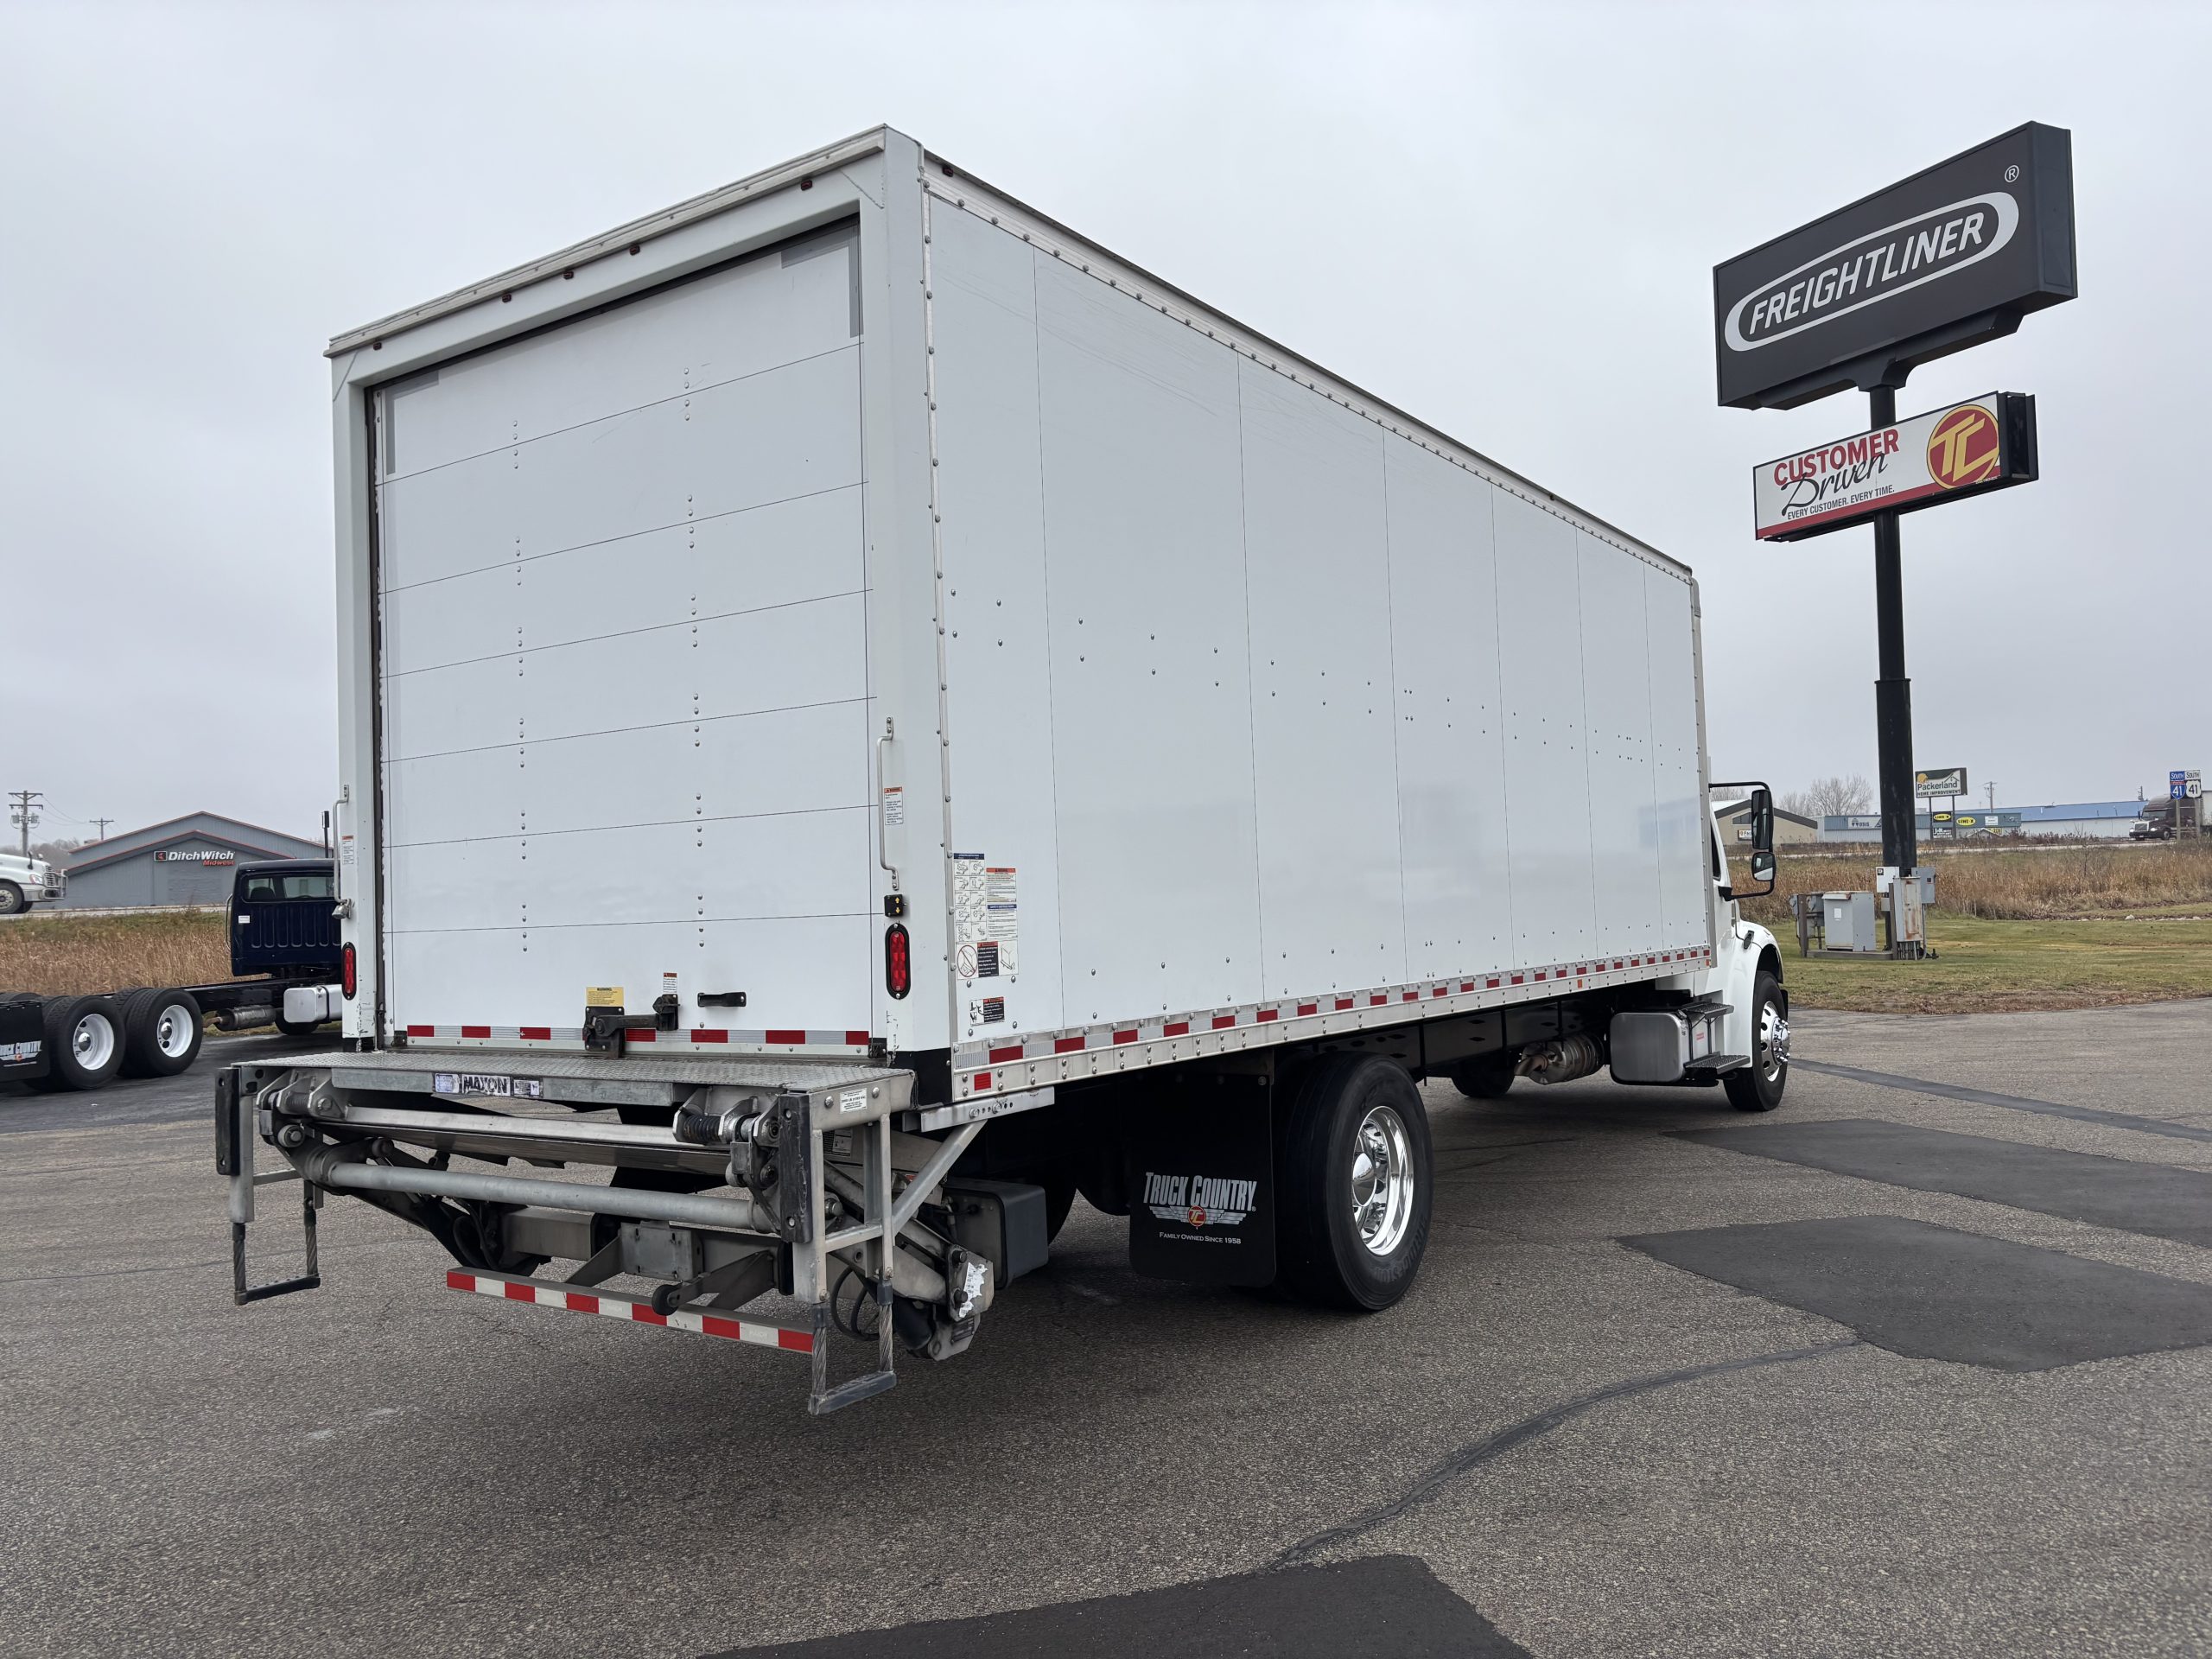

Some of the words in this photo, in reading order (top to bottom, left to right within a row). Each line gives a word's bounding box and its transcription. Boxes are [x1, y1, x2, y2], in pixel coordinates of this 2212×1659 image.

[1749, 212, 1985, 335] FREIGHTLINER
[1774, 429, 1899, 486] CUSTOMER
[1781, 451, 1888, 516] Driven
[1788, 507, 1808, 520] EVERY
[1809, 497, 1849, 515] CUSTOMER.
[1850, 490, 1873, 504] EVERY
[1874, 484, 1895, 498] TIME.
[1917, 780, 1958, 791] Packerland
[2172, 785, 2183, 796] 41
[2189, 784, 2198, 794] 41
[1143, 1172, 1189, 1206] TRUCK
[1190, 1175, 1257, 1211] COUNTRY
[1180, 1233, 1204, 1242] OWNED
